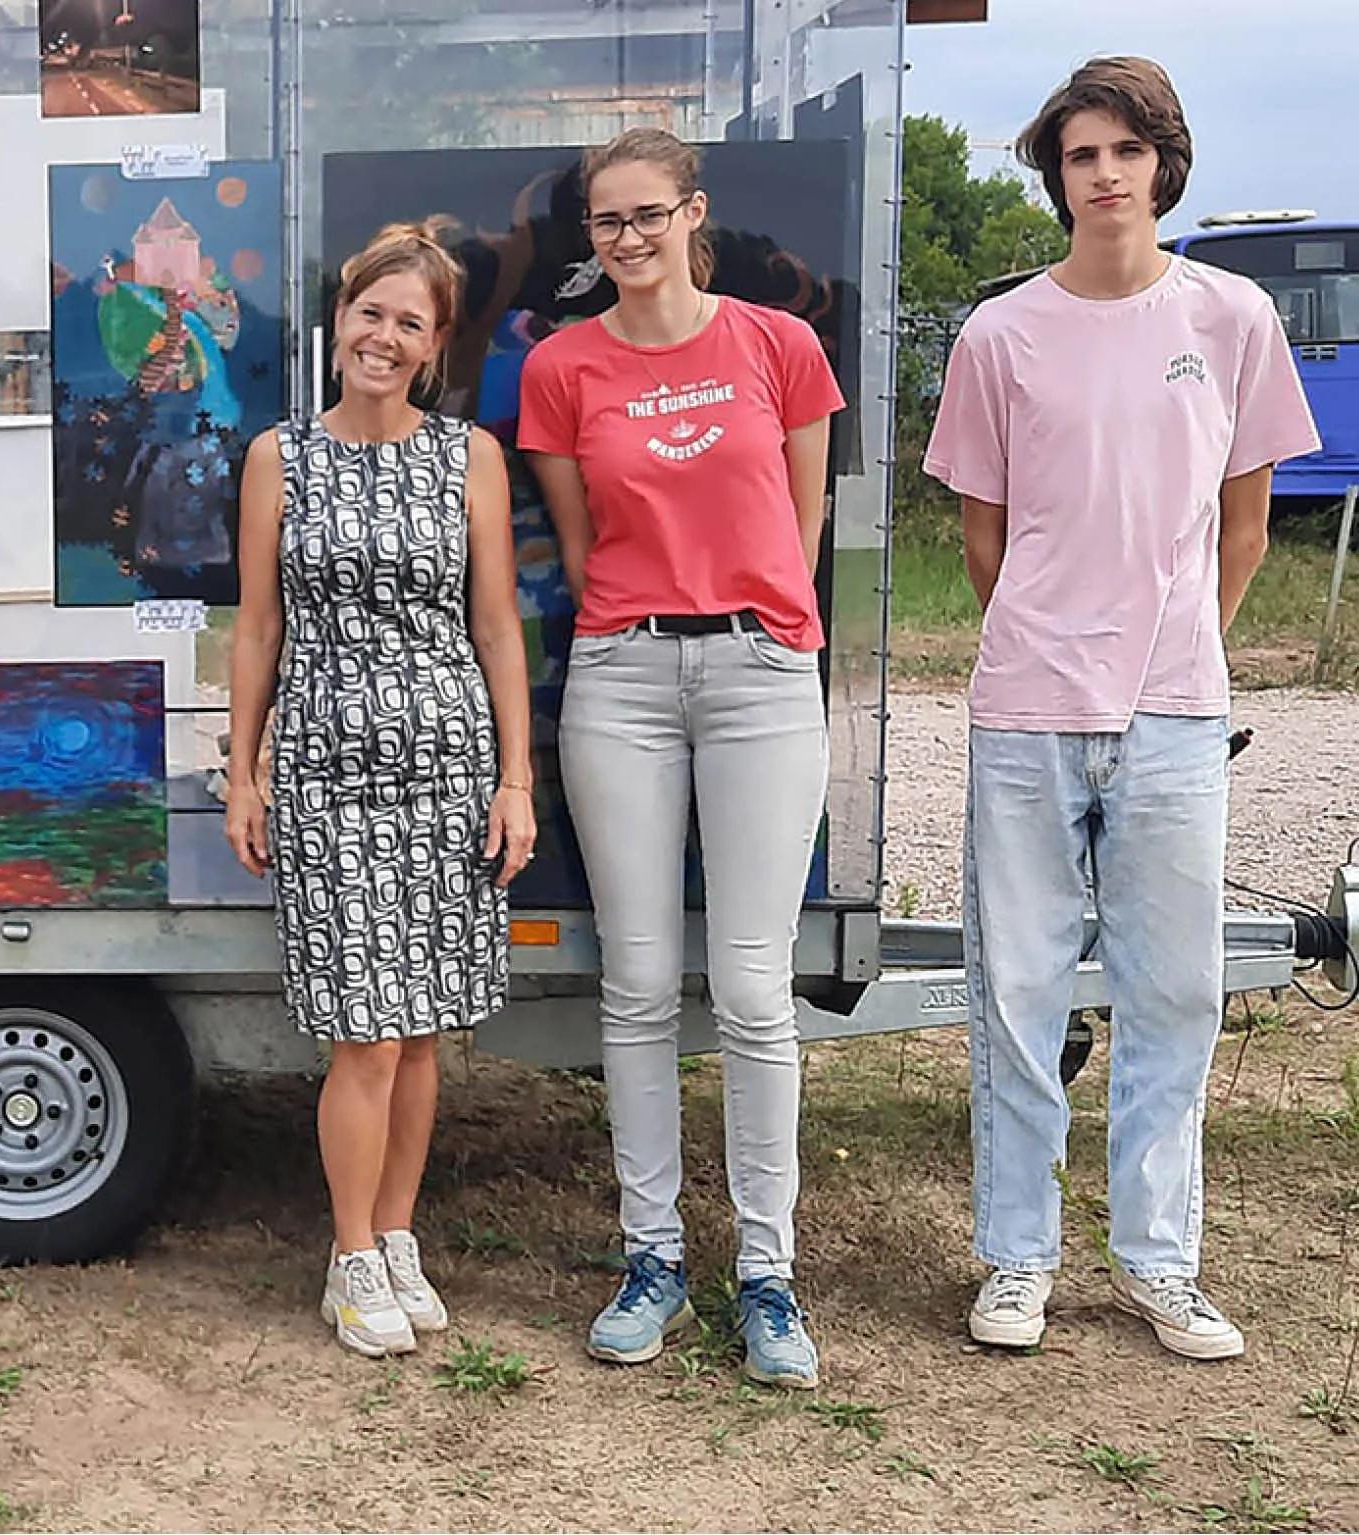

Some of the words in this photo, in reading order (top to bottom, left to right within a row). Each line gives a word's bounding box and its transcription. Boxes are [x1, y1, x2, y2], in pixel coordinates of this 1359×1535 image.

[626, 400, 656, 417] THE
[658, 384, 736, 414] SUNSHINE
[646, 424, 725, 460] WANDERERS
